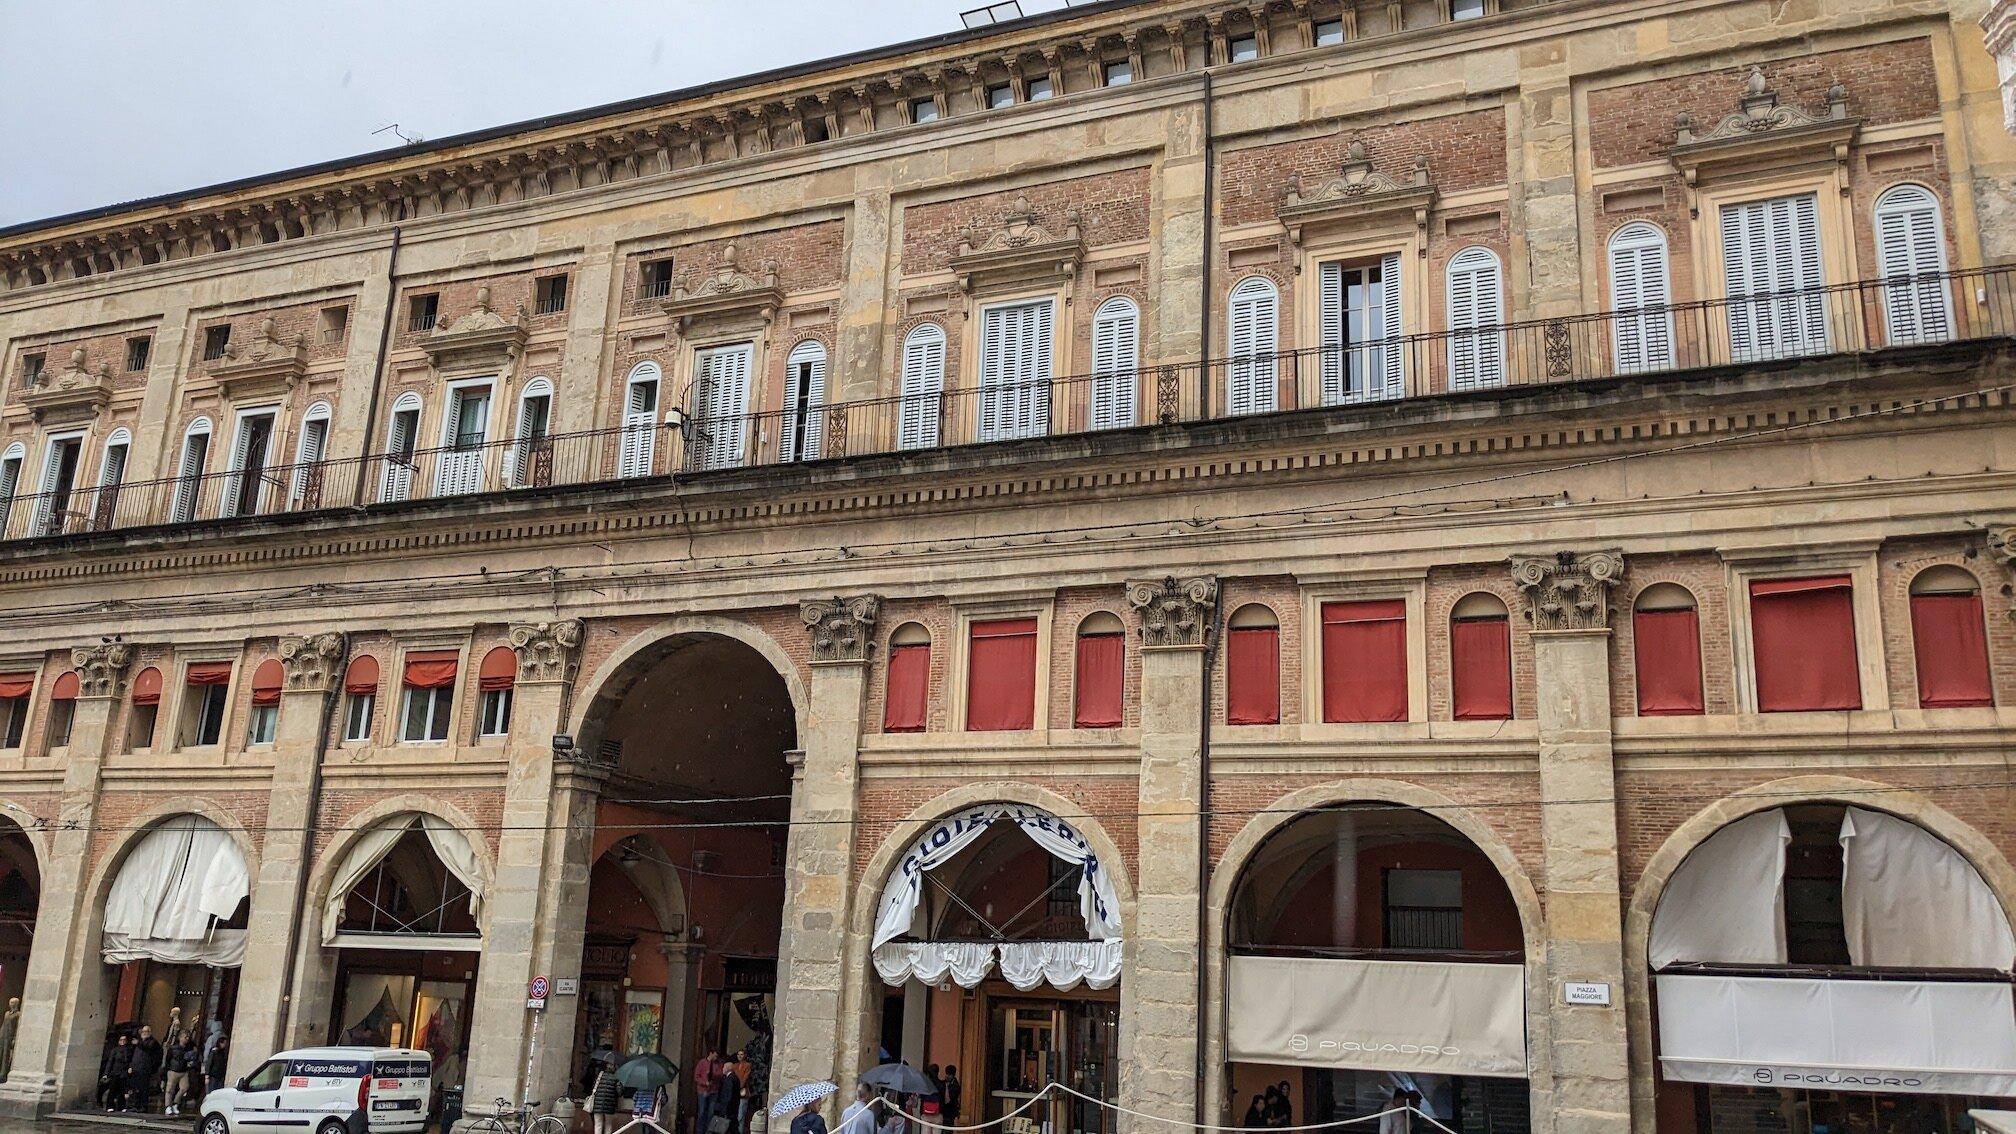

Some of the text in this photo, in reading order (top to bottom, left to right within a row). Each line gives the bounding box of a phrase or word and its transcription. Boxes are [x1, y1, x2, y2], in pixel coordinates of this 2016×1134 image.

[1320, 1040, 1460, 1055] PIQUADRO
[304, 1063, 328, 1074] Gruppo
[384, 1066, 406, 1074] Gruppo
[1784, 1073, 1922, 1086] PIQUADRO
